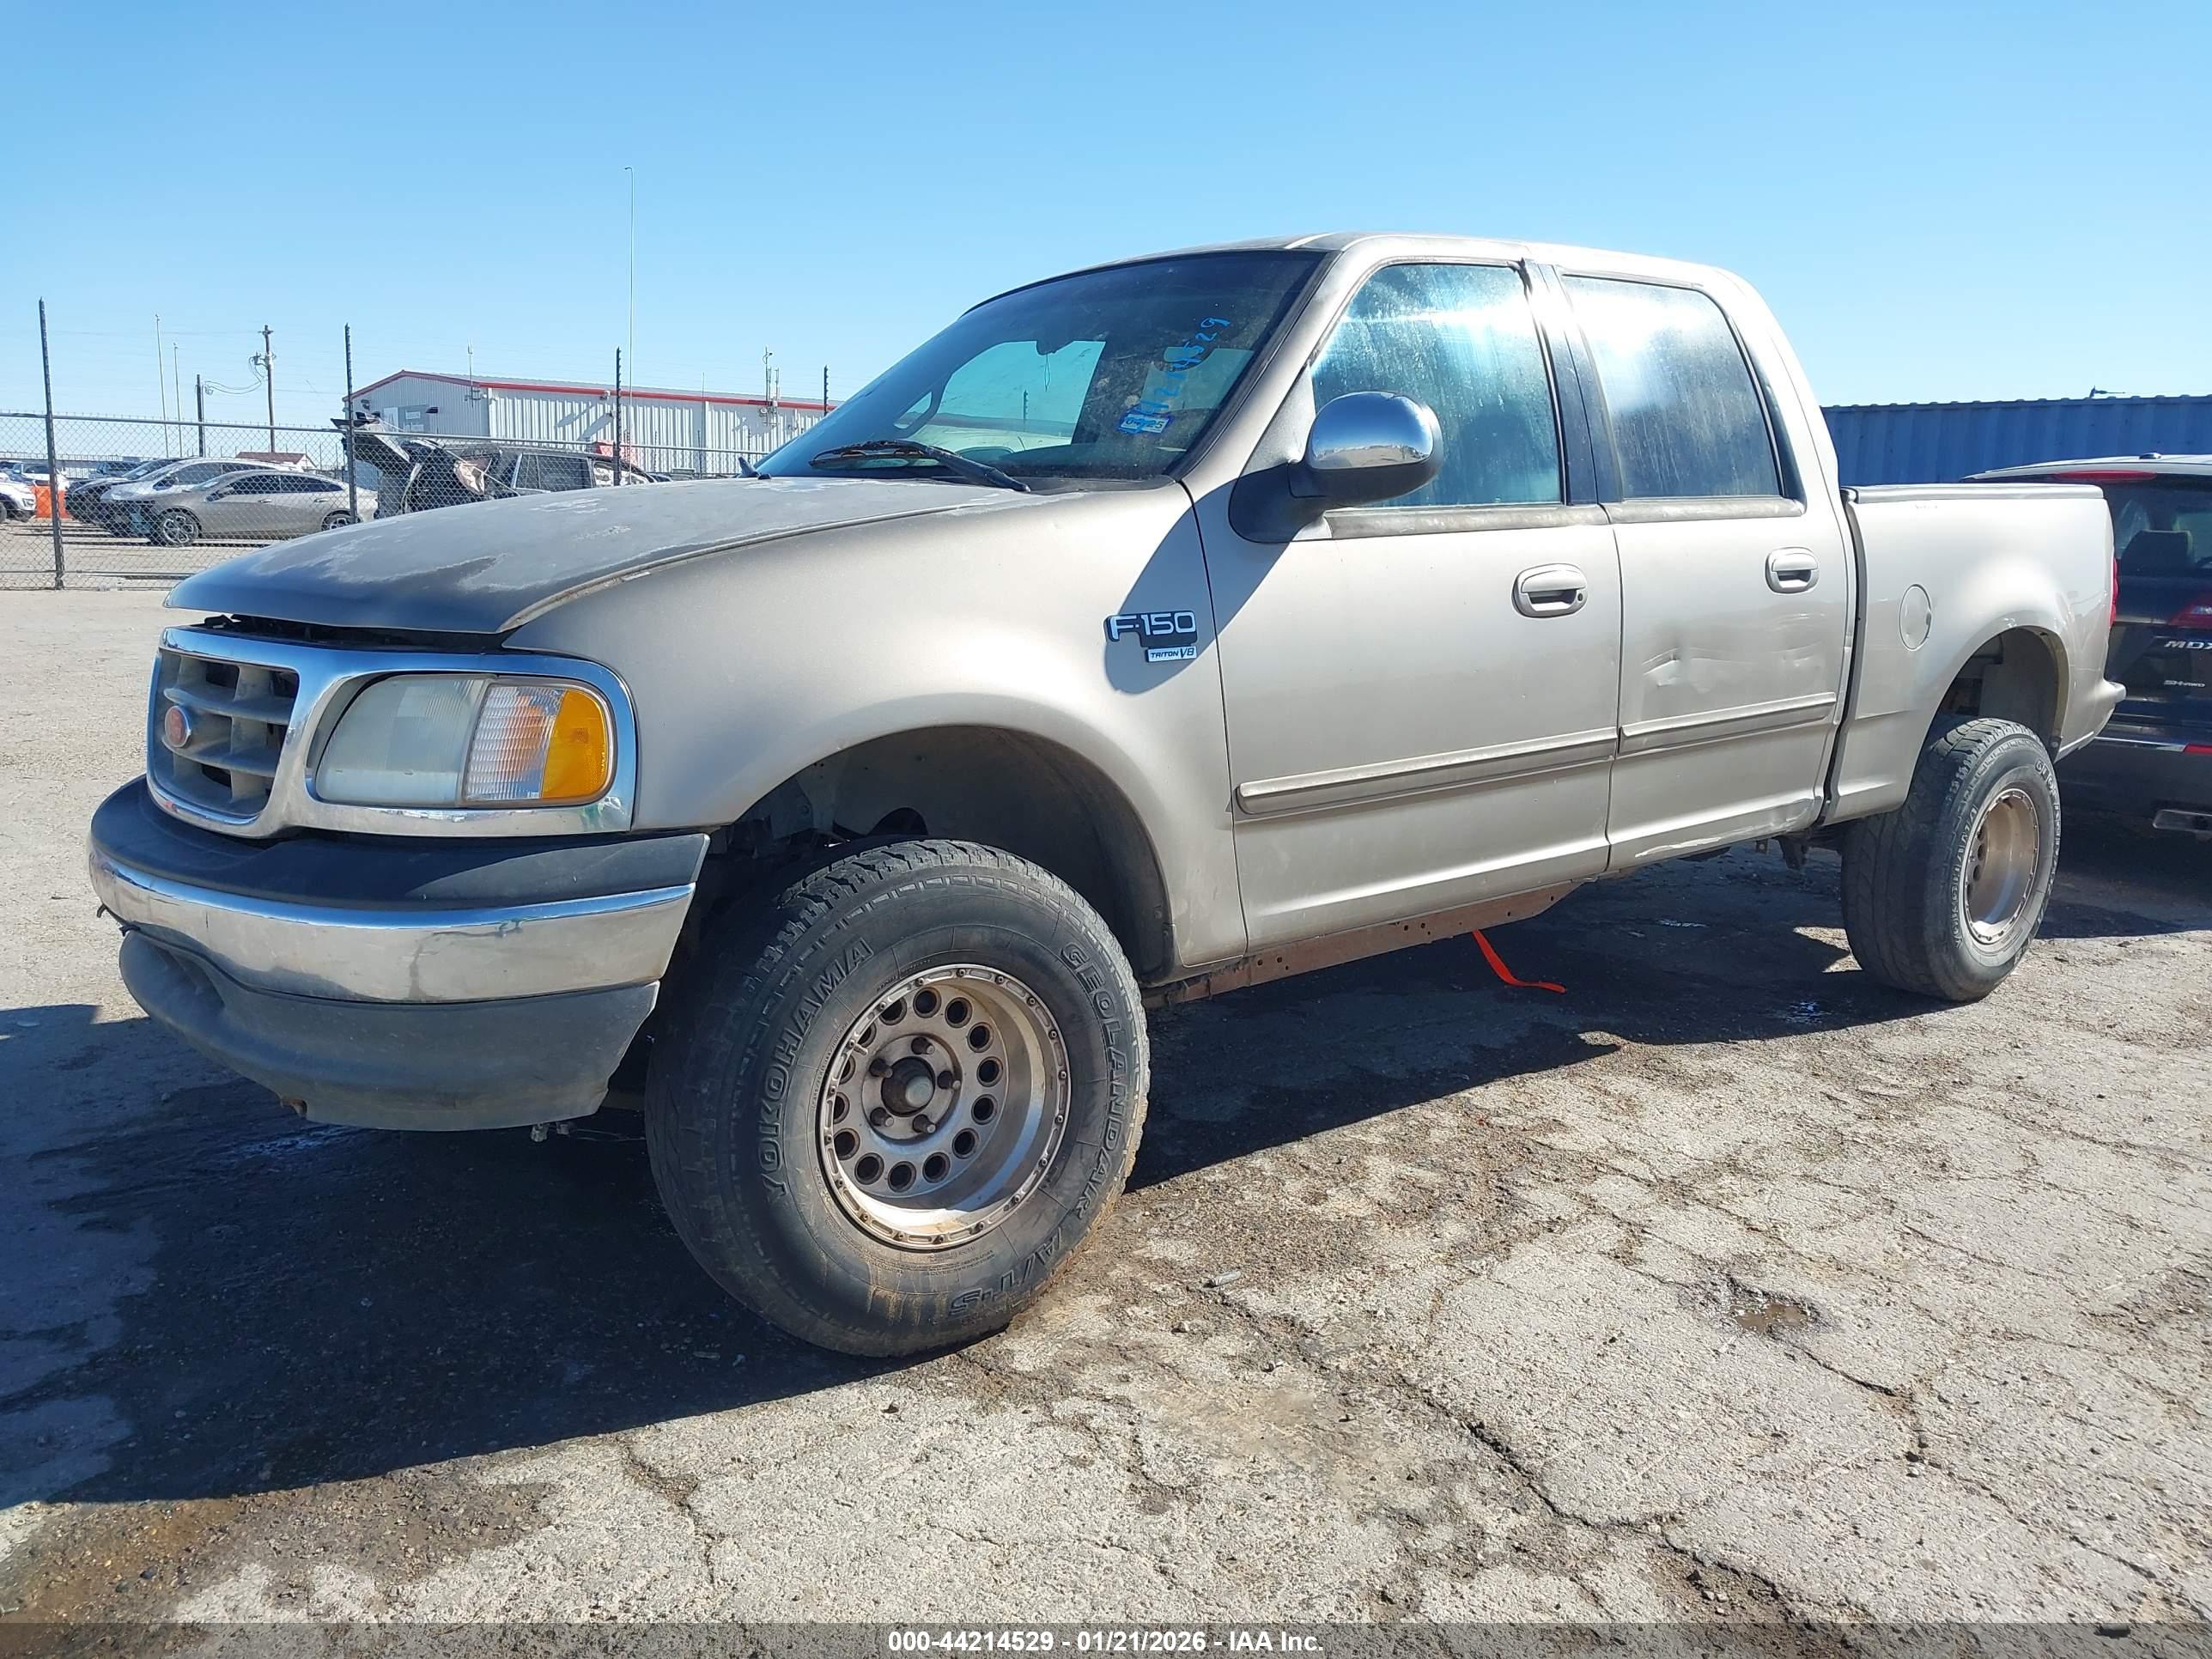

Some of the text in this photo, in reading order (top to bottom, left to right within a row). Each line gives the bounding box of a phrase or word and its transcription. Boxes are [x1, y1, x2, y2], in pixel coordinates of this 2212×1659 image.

[1150, 647, 1195, 659] TRITON V8
[757, 937, 874, 1196] YOKOHAMA
[1060, 942, 1127, 1220] GEOLANDAR
